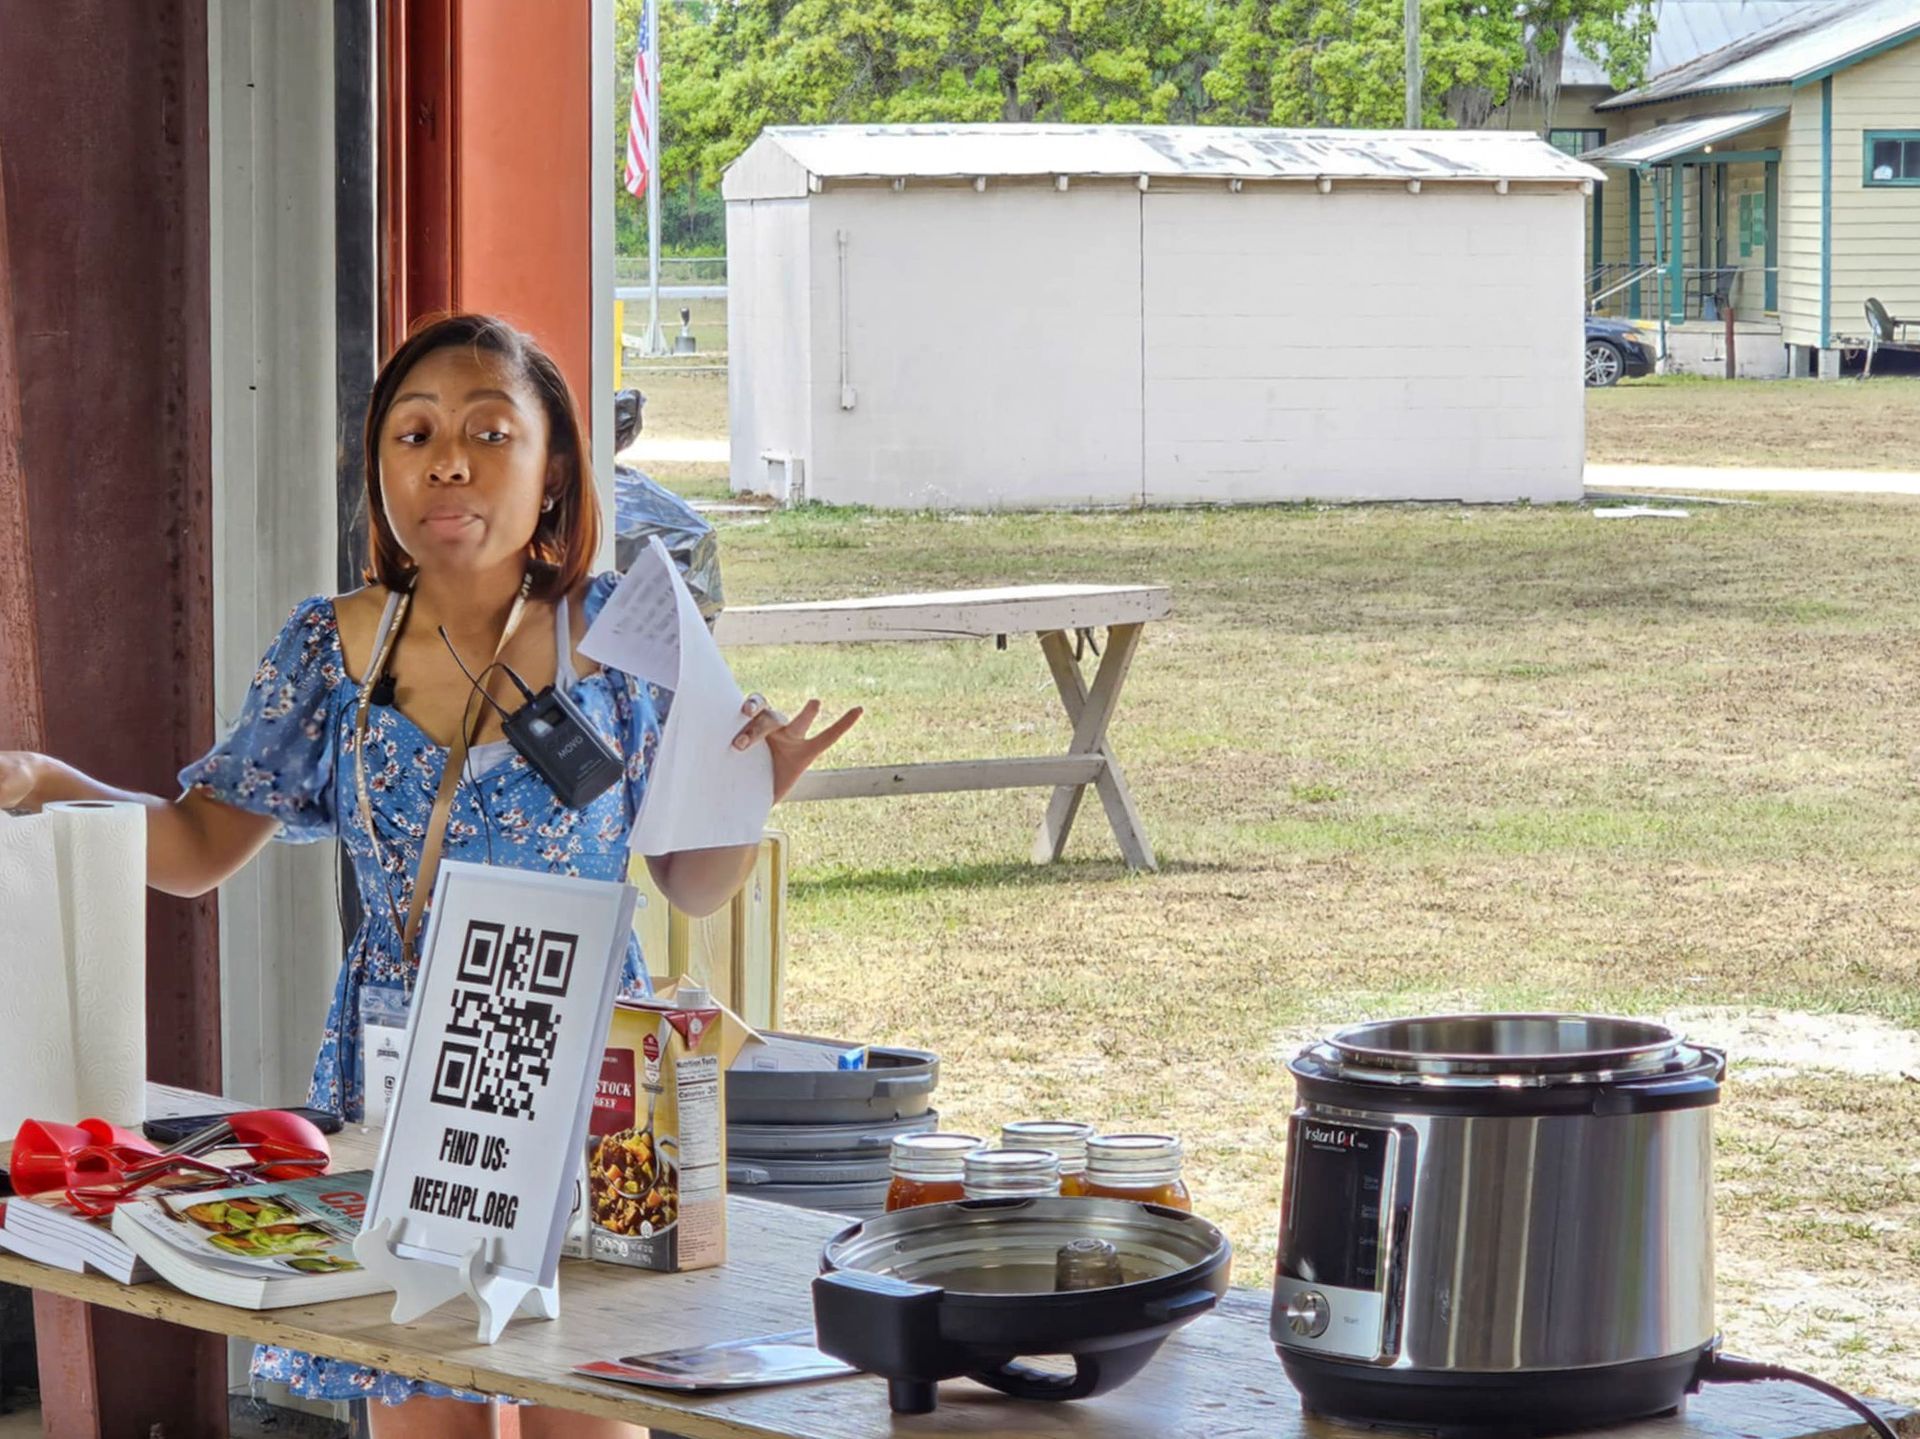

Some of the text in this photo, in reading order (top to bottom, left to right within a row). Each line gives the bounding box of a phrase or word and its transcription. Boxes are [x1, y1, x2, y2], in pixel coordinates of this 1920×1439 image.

[558, 735, 583, 760] MOVO
[439, 1127, 510, 1172] FIND US:
[1305, 1126, 1335, 1145] Instant
[409, 1175, 519, 1230] NEFLHPL.ORG
